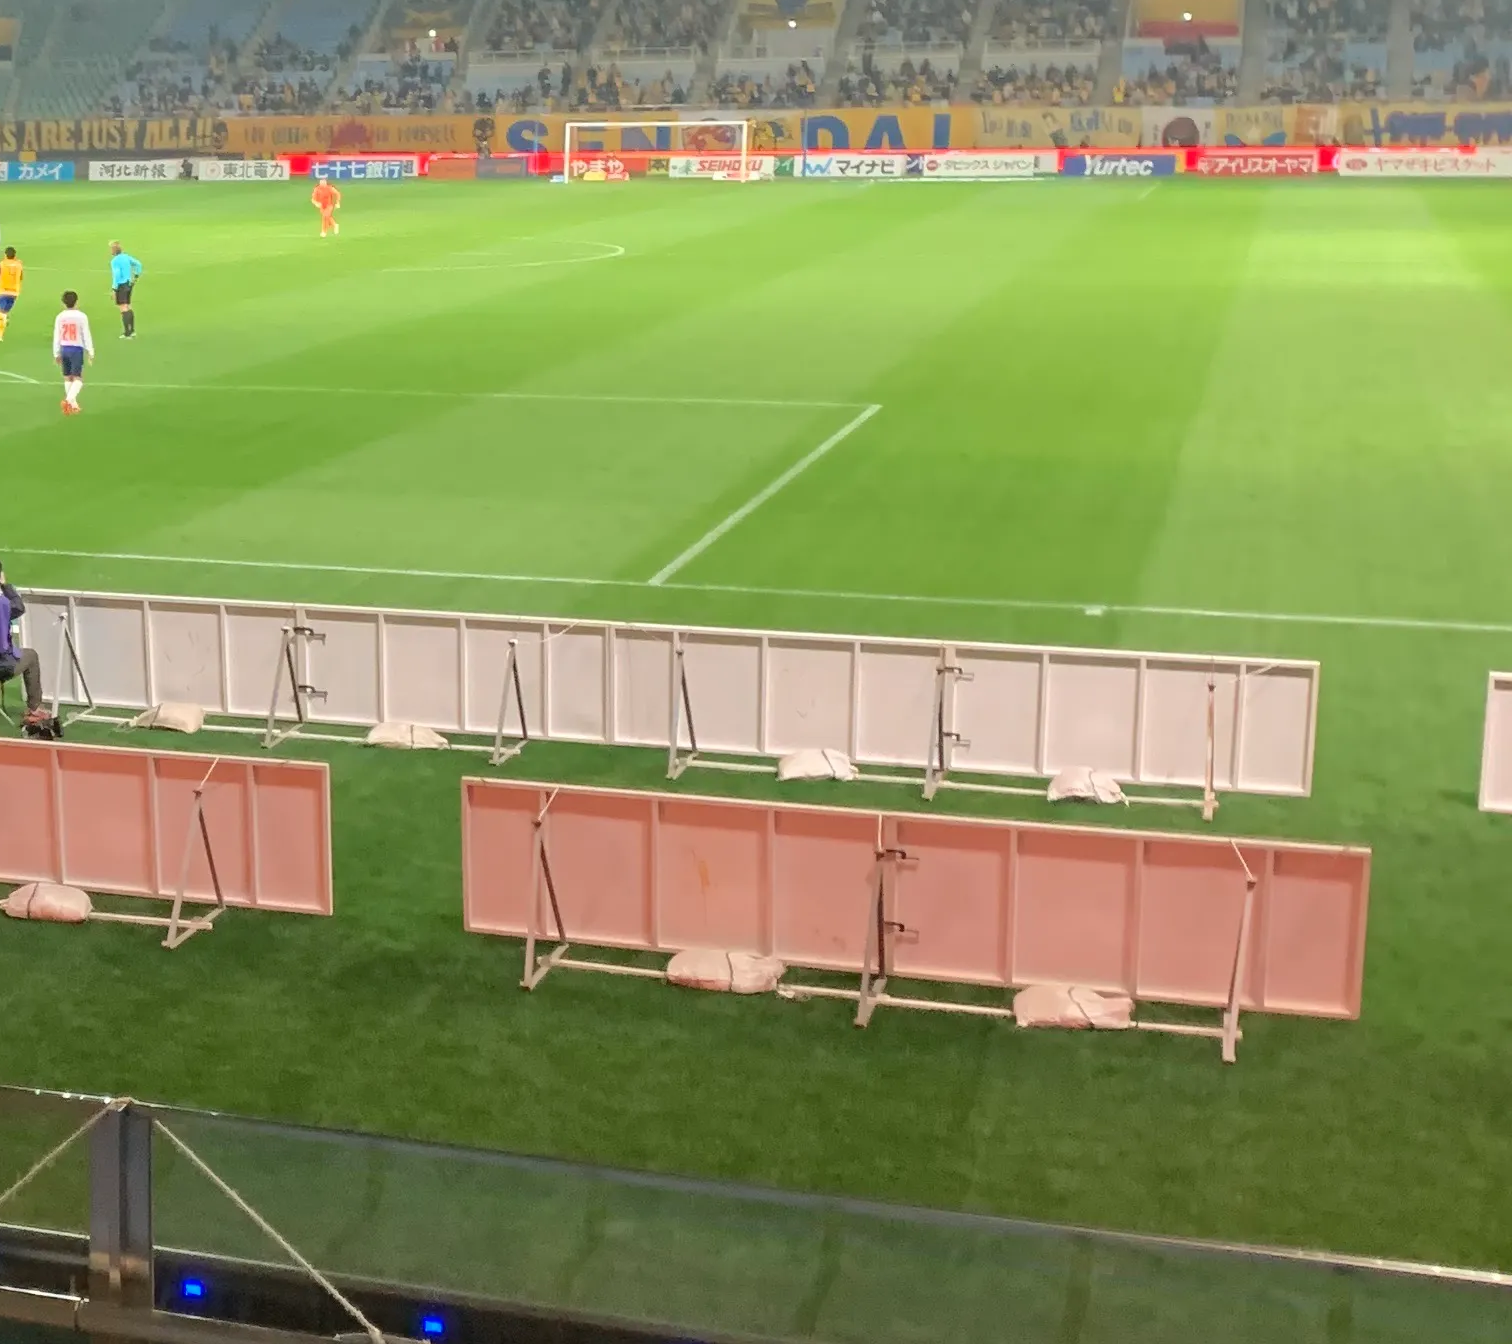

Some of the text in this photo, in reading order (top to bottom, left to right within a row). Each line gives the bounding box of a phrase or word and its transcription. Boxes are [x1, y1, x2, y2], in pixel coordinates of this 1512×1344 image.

[21, 119, 76, 151] ARE
[79, 119, 139, 151] JUST
[18, 163, 63, 180] カメイ
[98, 163, 168, 179] 河北新報
[222, 163, 284, 179] 東北電力
[311, 160, 402, 179] 七十七銀行
[570, 159, 625, 177] やまや
[837, 159, 895, 175] マイナビ
[1084, 154, 1154, 176] Yurtec
